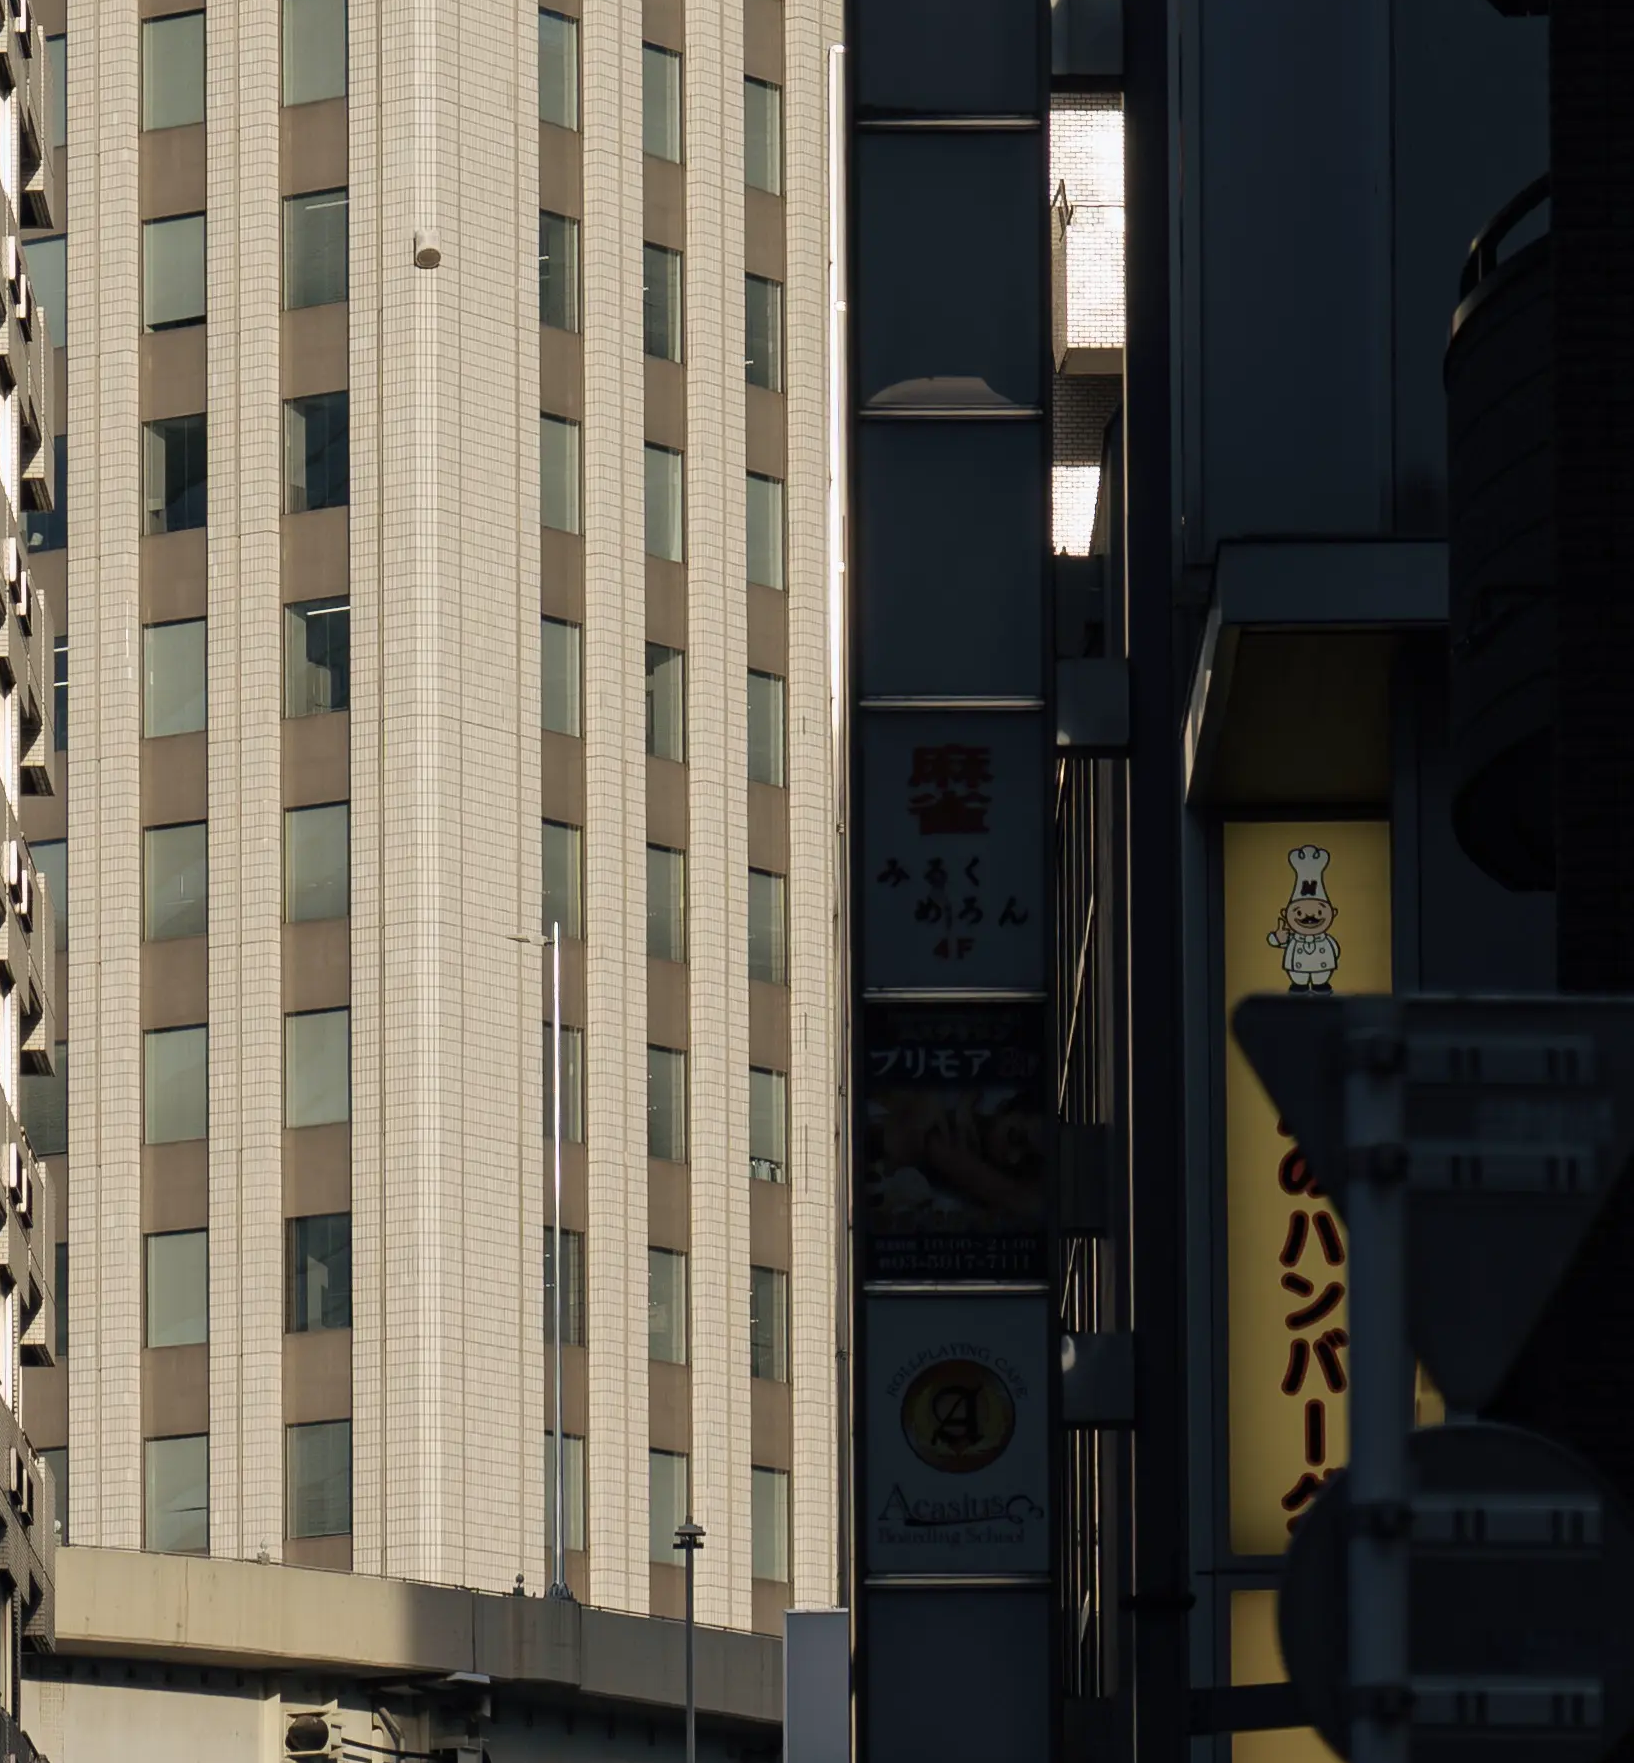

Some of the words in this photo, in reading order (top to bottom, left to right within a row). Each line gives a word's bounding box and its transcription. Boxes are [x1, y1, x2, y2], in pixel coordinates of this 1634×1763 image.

[876, 855, 980, 887] みるく
[914, 895, 1029, 928] めろん
[933, 938, 975, 960] 4F
